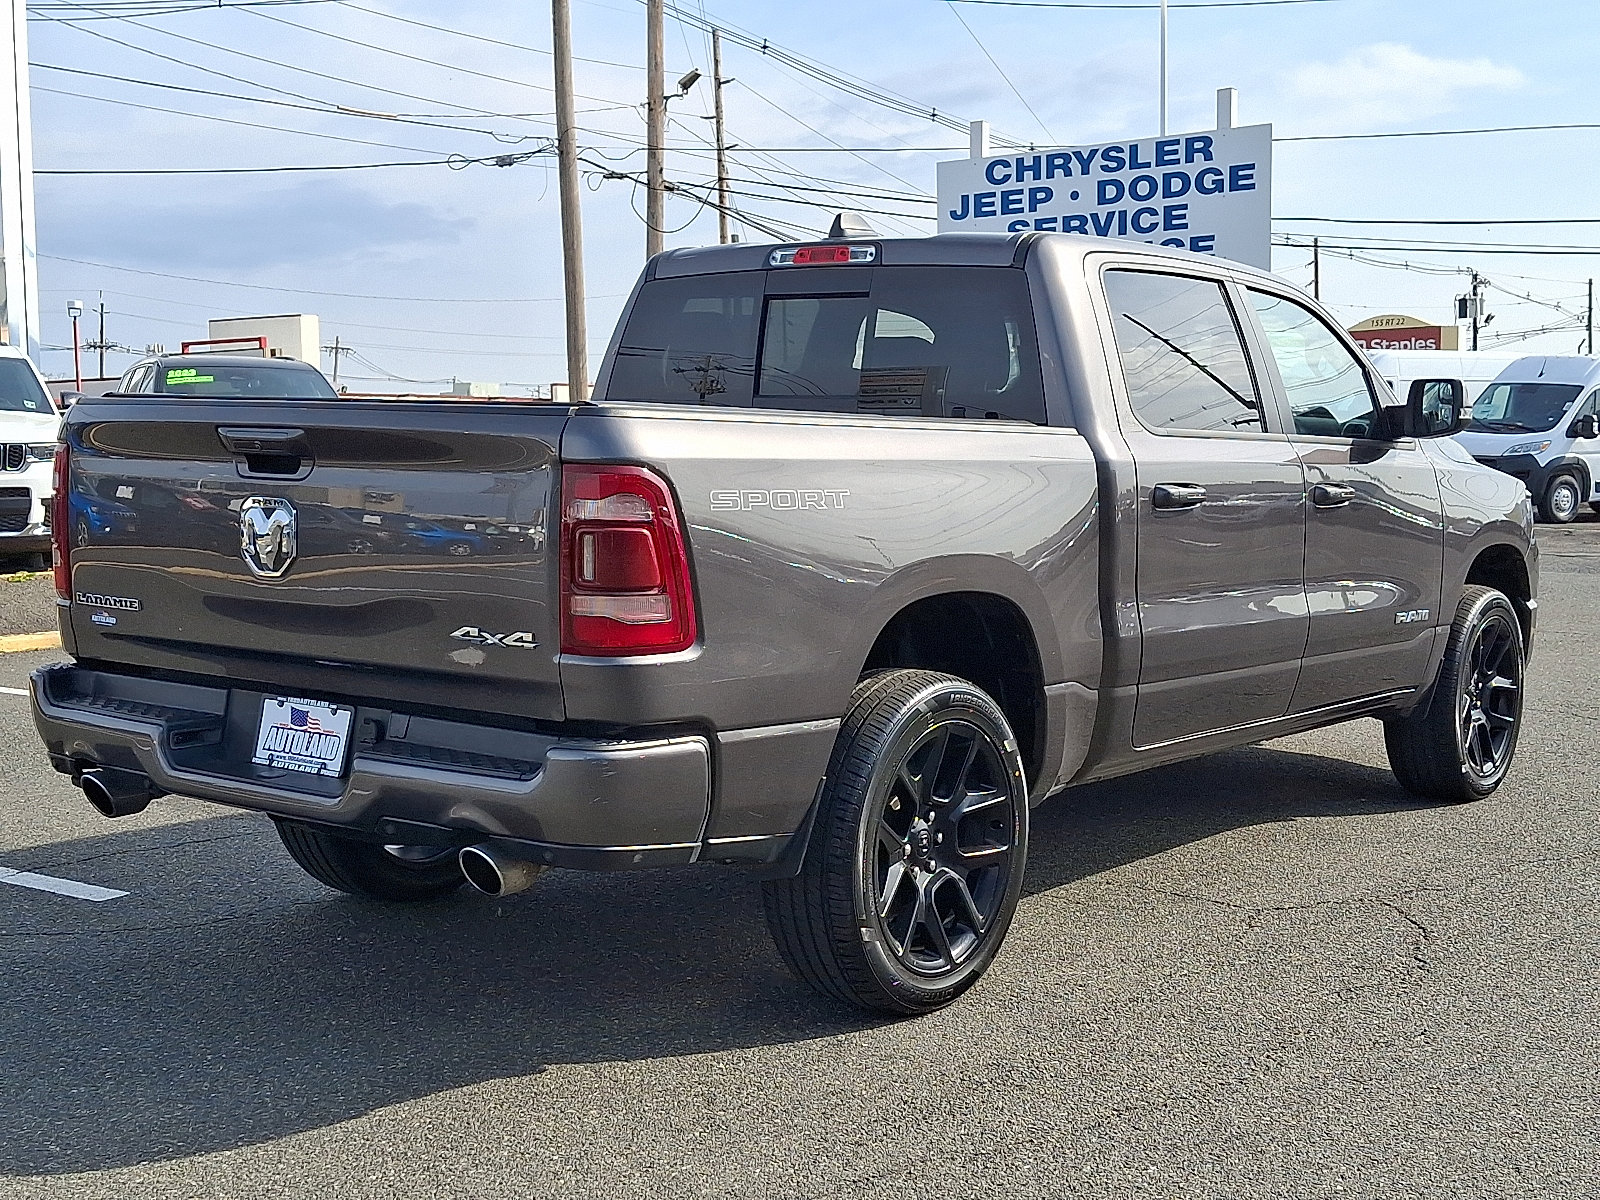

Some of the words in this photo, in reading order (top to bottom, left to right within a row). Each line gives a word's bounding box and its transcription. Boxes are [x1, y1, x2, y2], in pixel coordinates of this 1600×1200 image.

[985, 135, 1214, 186] CHRYSLER
[949, 187, 1054, 221] JEEP
[1096, 162, 1257, 207] DODGE
[1396, 317, 1406, 325] 22
[1370, 337, 1436, 350] Staples
[252, 499, 284, 507] RAM
[710, 489, 850, 511] SPORT
[76, 592, 139, 611] LARAMIE
[1395, 609, 1430, 625] RAM
[263, 727, 340, 760] AUTOLAND
[272, 761, 318, 774] AUTOLAND
